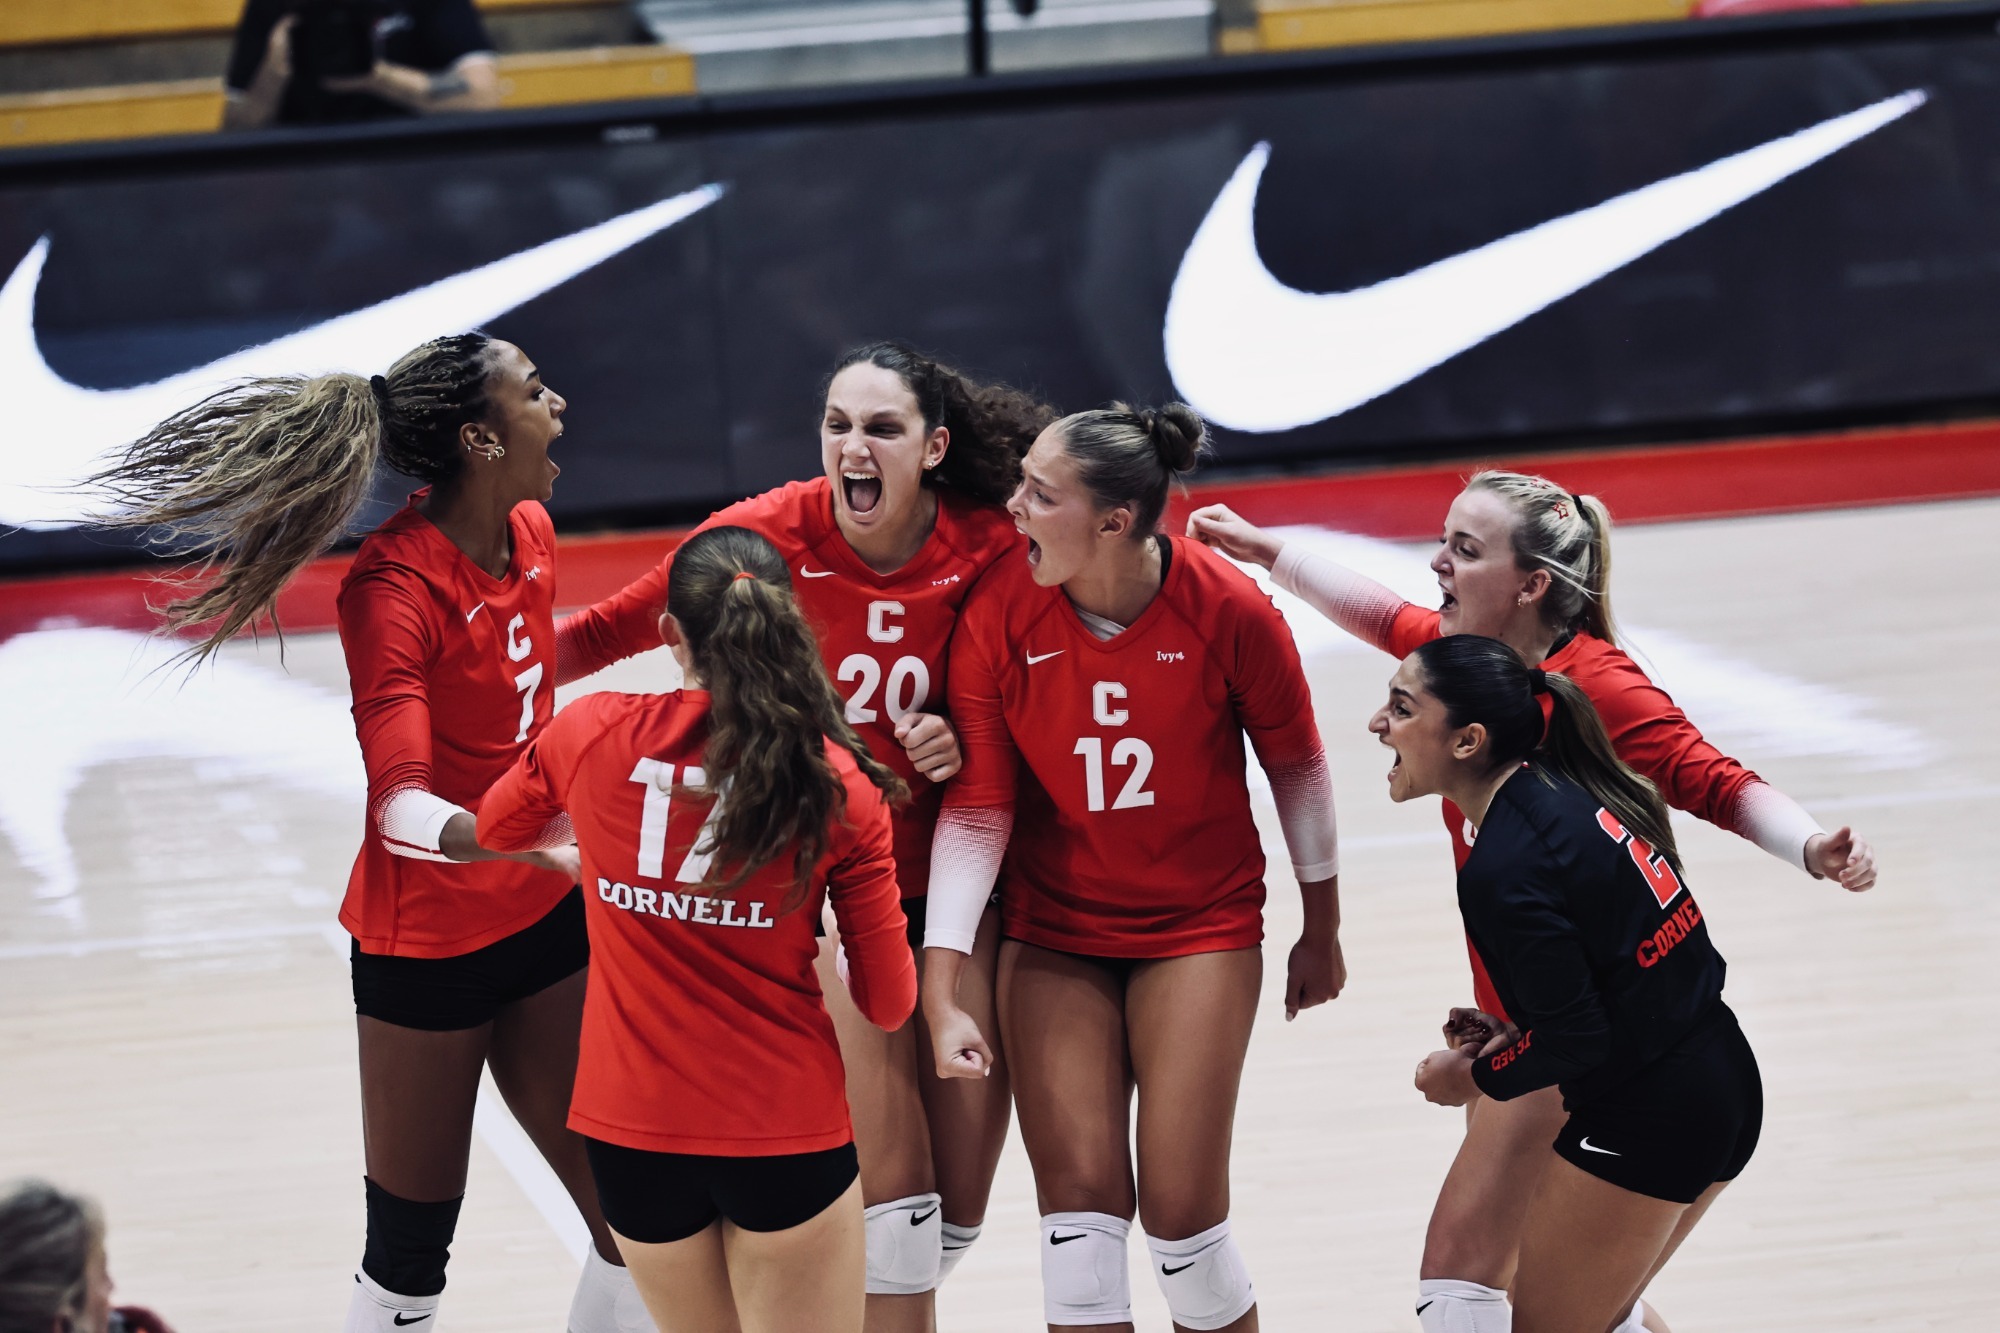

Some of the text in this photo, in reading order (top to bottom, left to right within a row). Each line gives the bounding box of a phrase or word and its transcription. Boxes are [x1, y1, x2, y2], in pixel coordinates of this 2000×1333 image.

[508, 612, 532, 662] C
[868, 600, 905, 643] C
[1156, 650, 1175, 663] Ivy
[514, 661, 543, 744] 7
[837, 653, 930, 725] 20
[1092, 680, 1129, 726] C
[1073, 737, 1155, 812] 12
[597, 877, 774, 928] CORNELL
[1636, 896, 1703, 968] CORNE
[1491, 1046, 1516, 1071] RED
